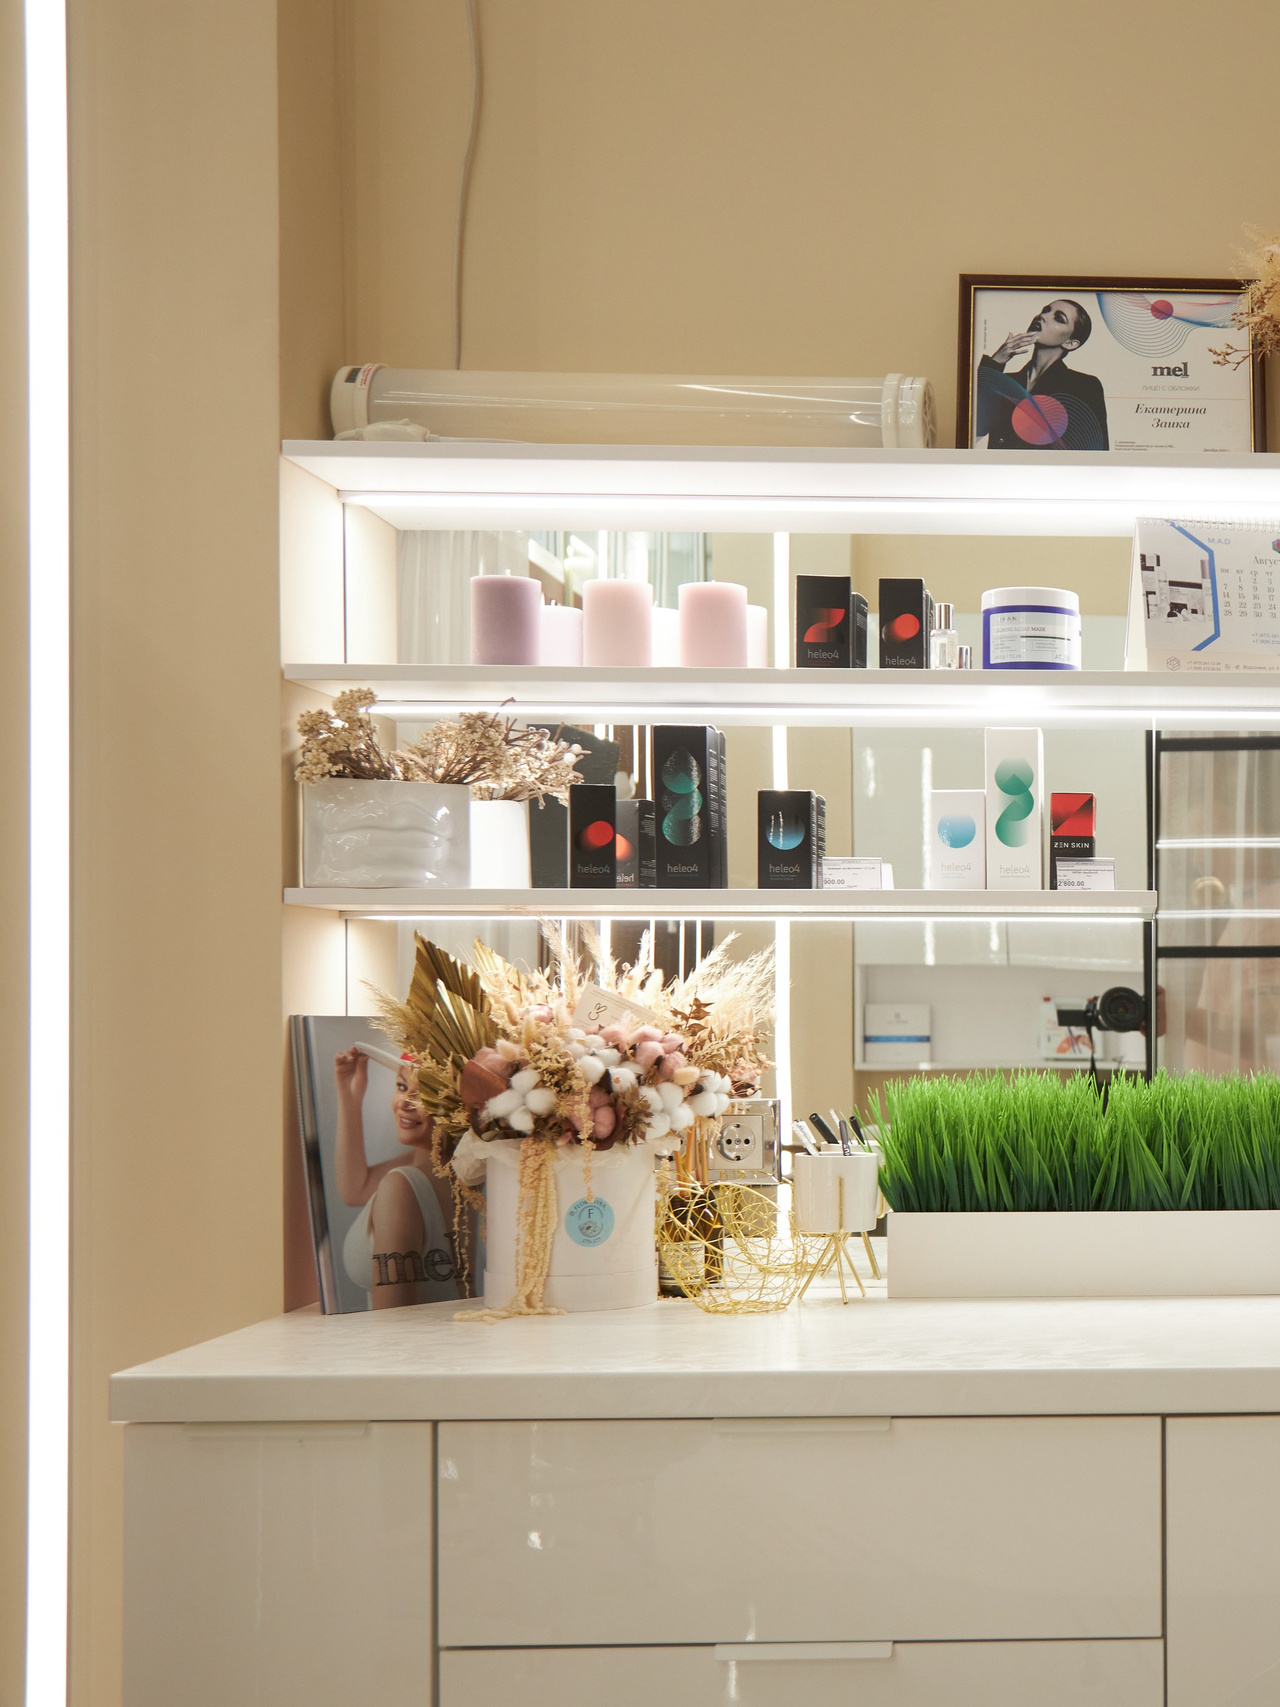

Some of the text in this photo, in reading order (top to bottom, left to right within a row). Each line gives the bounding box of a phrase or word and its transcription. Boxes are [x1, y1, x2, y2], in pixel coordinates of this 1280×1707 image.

[1151, 361, 1190, 379] mel
[1135, 403, 1207, 417] Екатерина
[1151, 418, 1190, 429] Заика
[1267, 586, 1275, 594] 10
[1252, 602, 1262, 610] 23
[807, 648, 839, 660] heleo4
[885, 656, 916, 666] heleo4
[577, 864, 611, 874] heleo4
[667, 863, 699, 873] heleo4
[769, 863, 801, 874] heleo4
[941, 862, 972, 872] heleo4
[1000, 865, 1031, 874] heleo4
